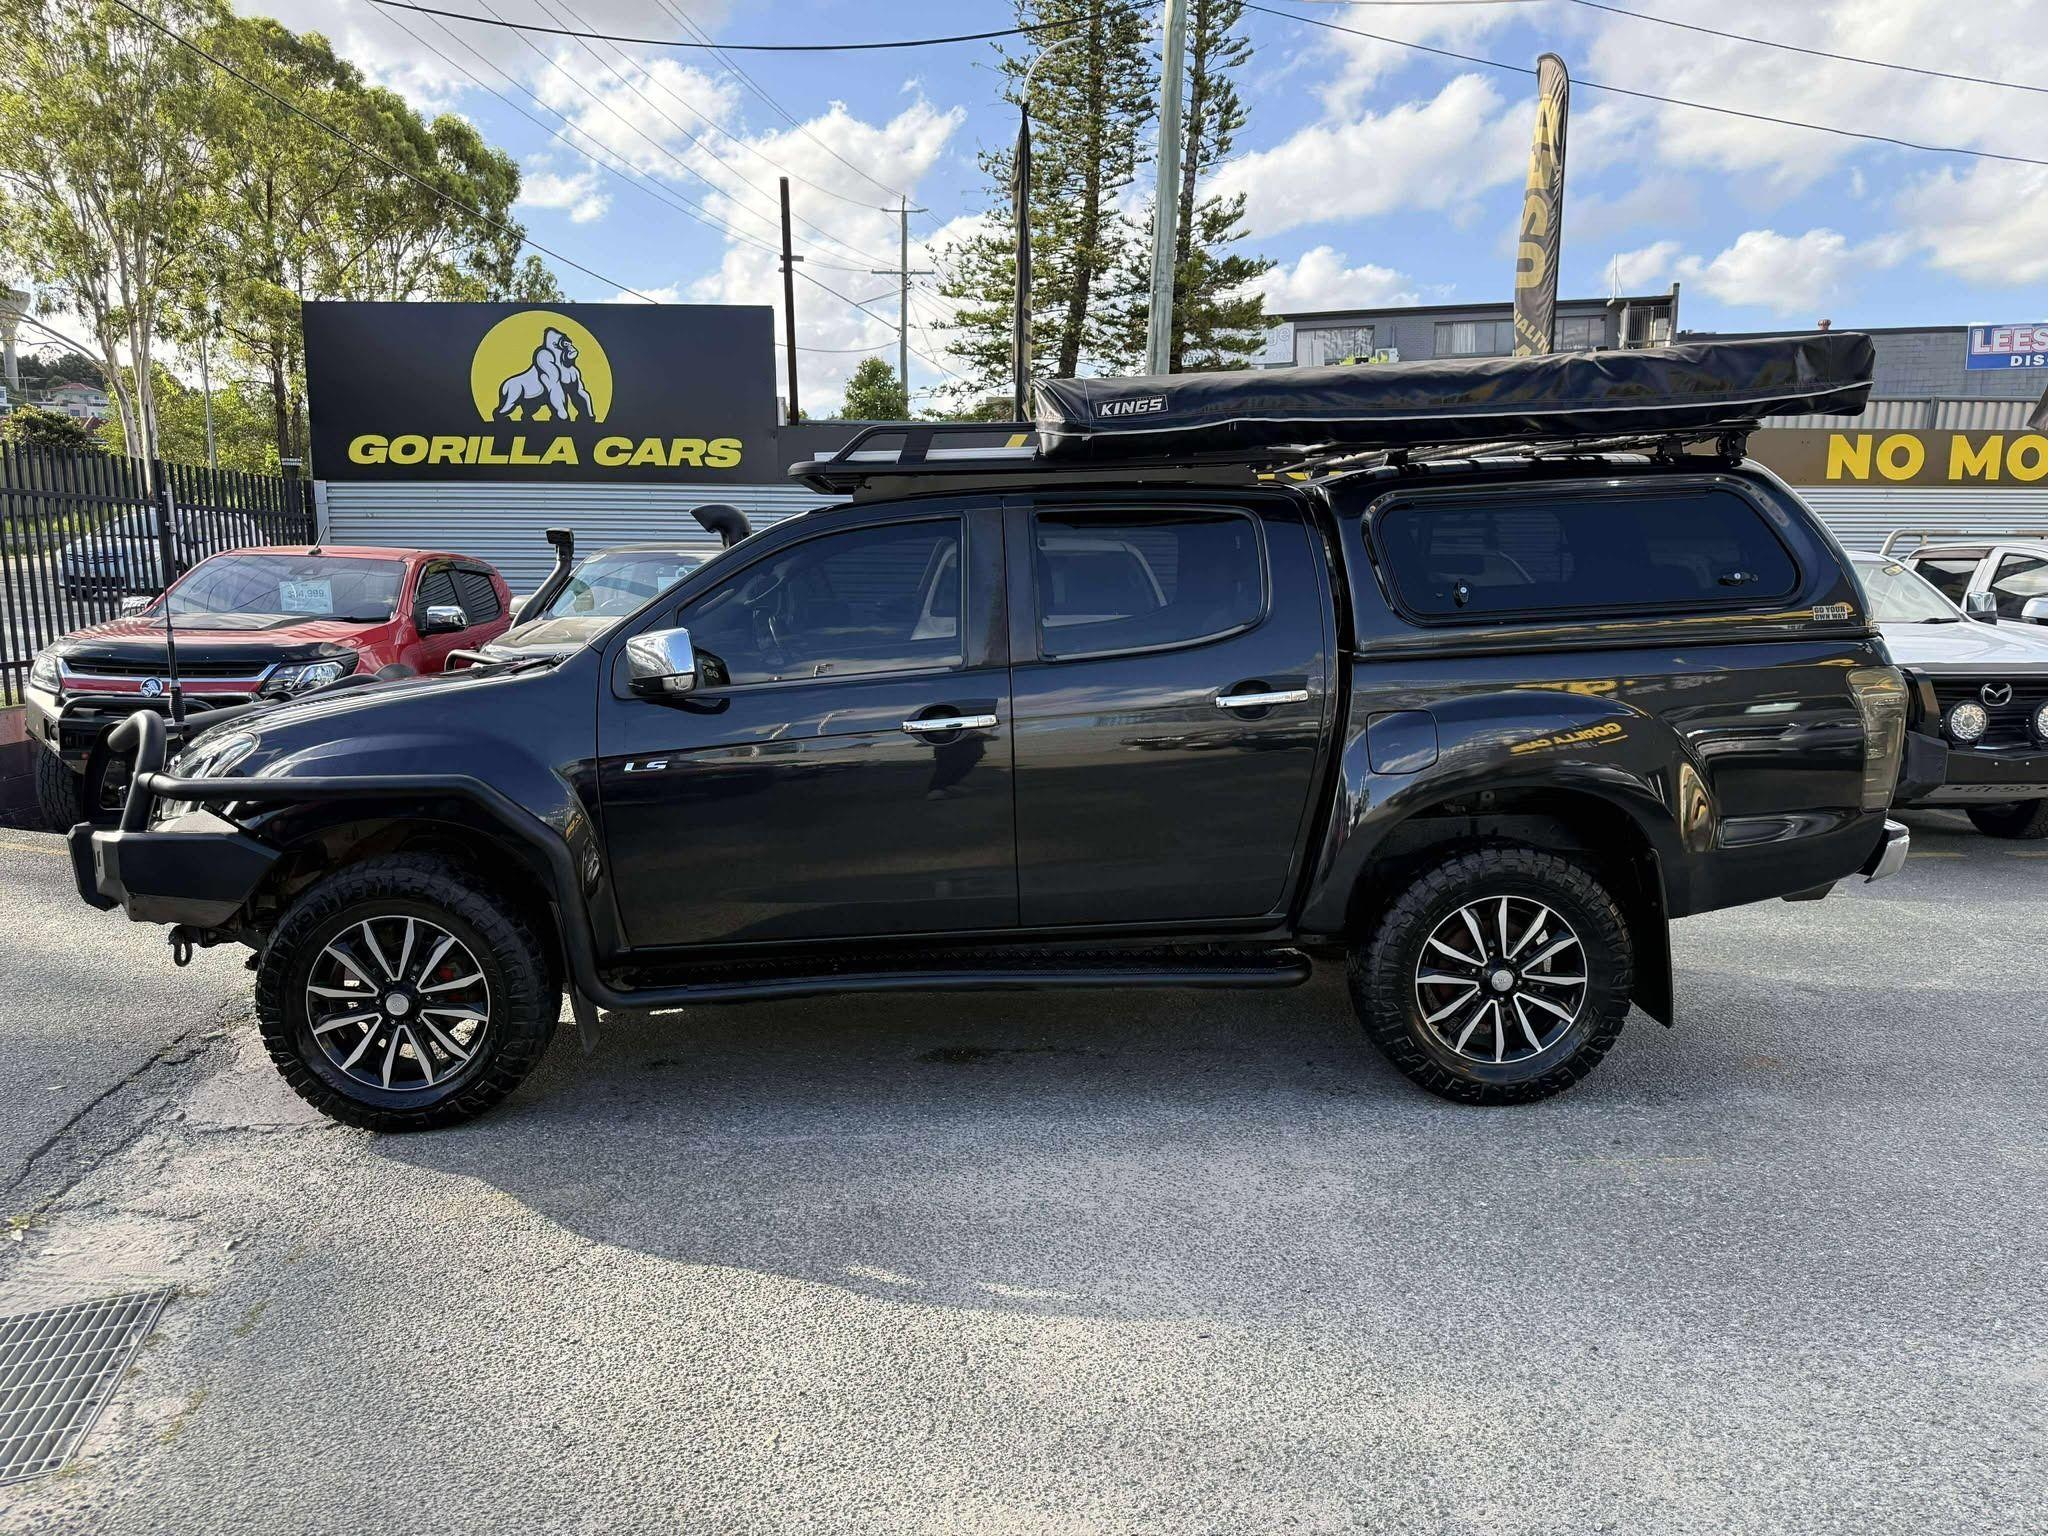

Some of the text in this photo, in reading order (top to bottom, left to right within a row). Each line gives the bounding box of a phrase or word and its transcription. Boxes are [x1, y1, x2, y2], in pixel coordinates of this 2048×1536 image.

[1971, 328, 2048, 354] LEES
[2010, 354, 2048, 367] DIS
[1101, 398, 1163, 416] KINGS
[348, 434, 742, 468] GORILLA CARS
[1826, 433, 2048, 481] NO MO
[623, 760, 669, 773] LS
